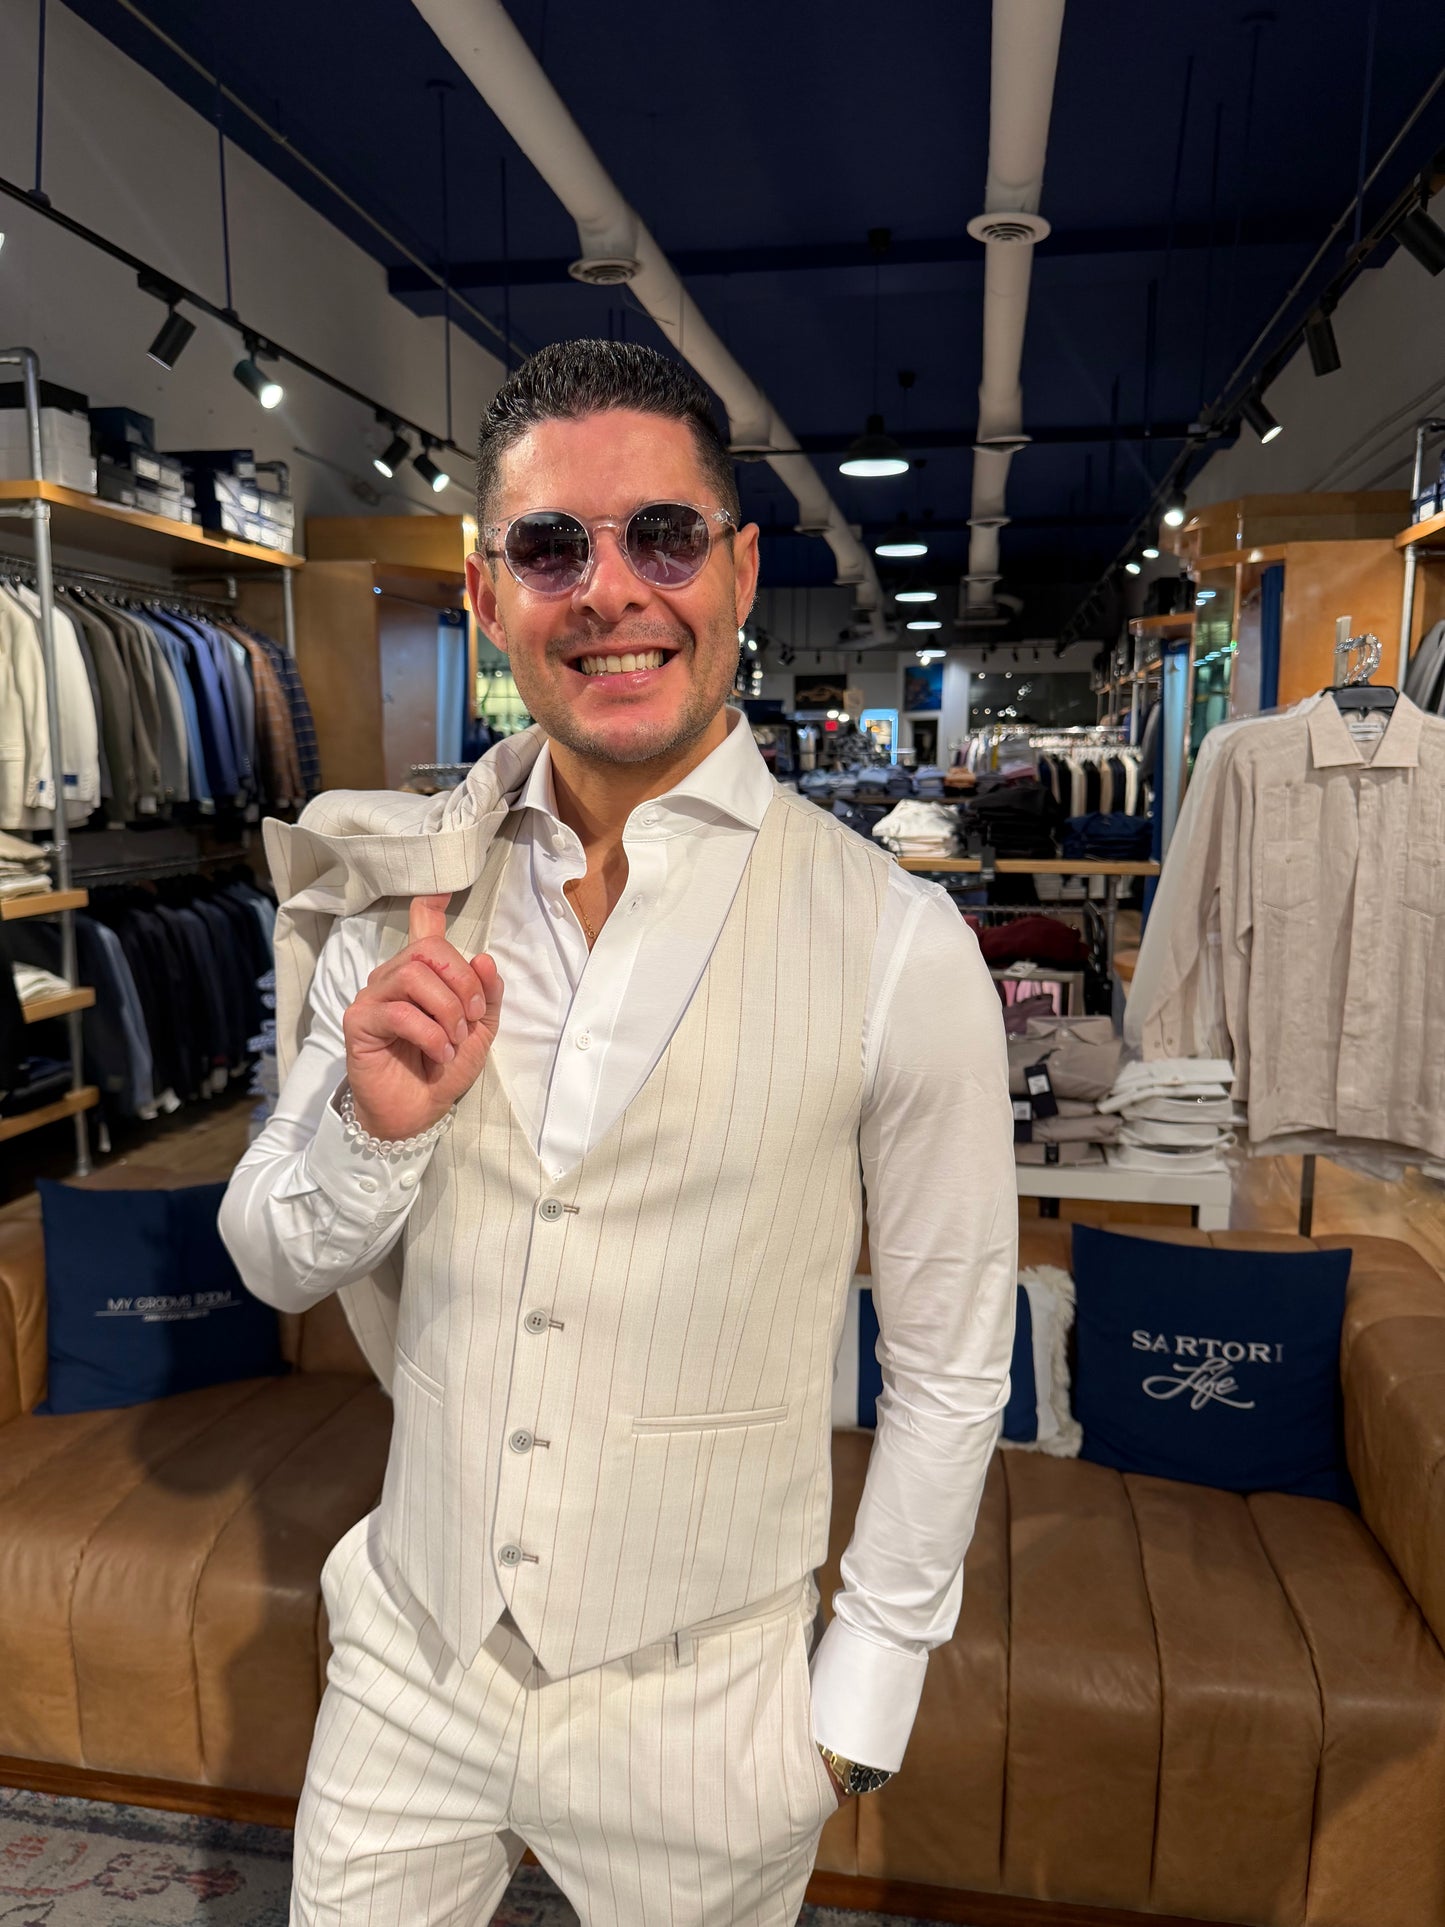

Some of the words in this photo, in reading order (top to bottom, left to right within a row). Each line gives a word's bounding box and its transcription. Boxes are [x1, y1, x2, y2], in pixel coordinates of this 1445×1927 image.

[107, 1298, 133, 1311] MY
[1132, 1330, 1283, 1363] SARTORI
[1142, 1357, 1255, 1410] Life
